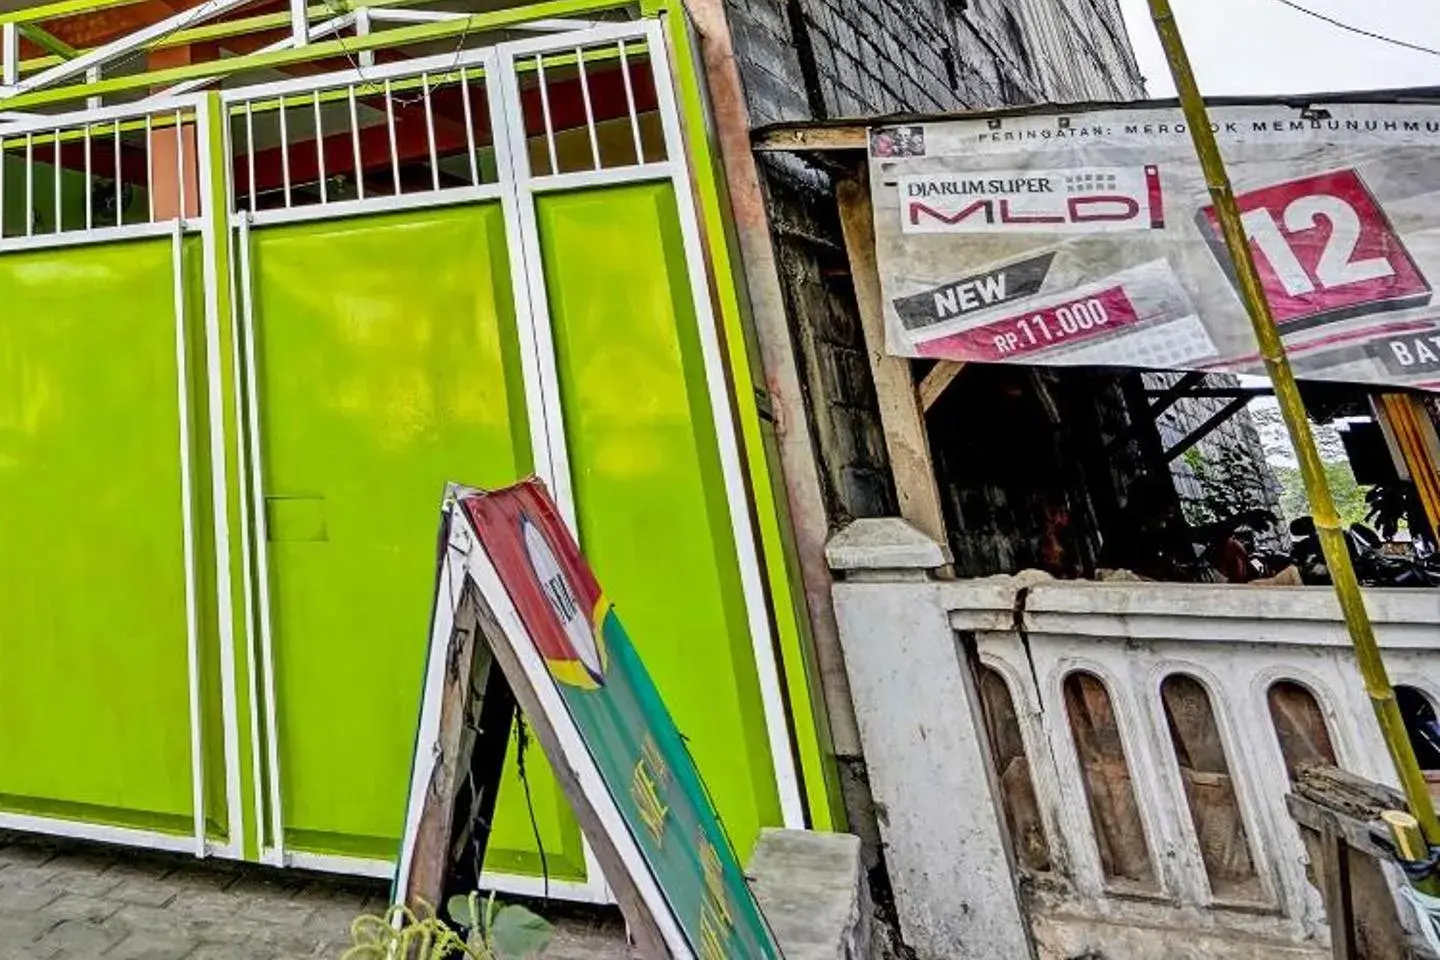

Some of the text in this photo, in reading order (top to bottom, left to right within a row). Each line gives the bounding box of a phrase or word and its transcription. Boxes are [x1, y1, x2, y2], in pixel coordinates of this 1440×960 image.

[1125, 120, 1237, 134] MEROOK
[1252, 117, 1440, 133] MEMBUNUHMU
[908, 177, 1053, 197] DJARUM SUPER
[1240, 194, 1396, 297] 12
[933, 272, 1007, 318] NEW
